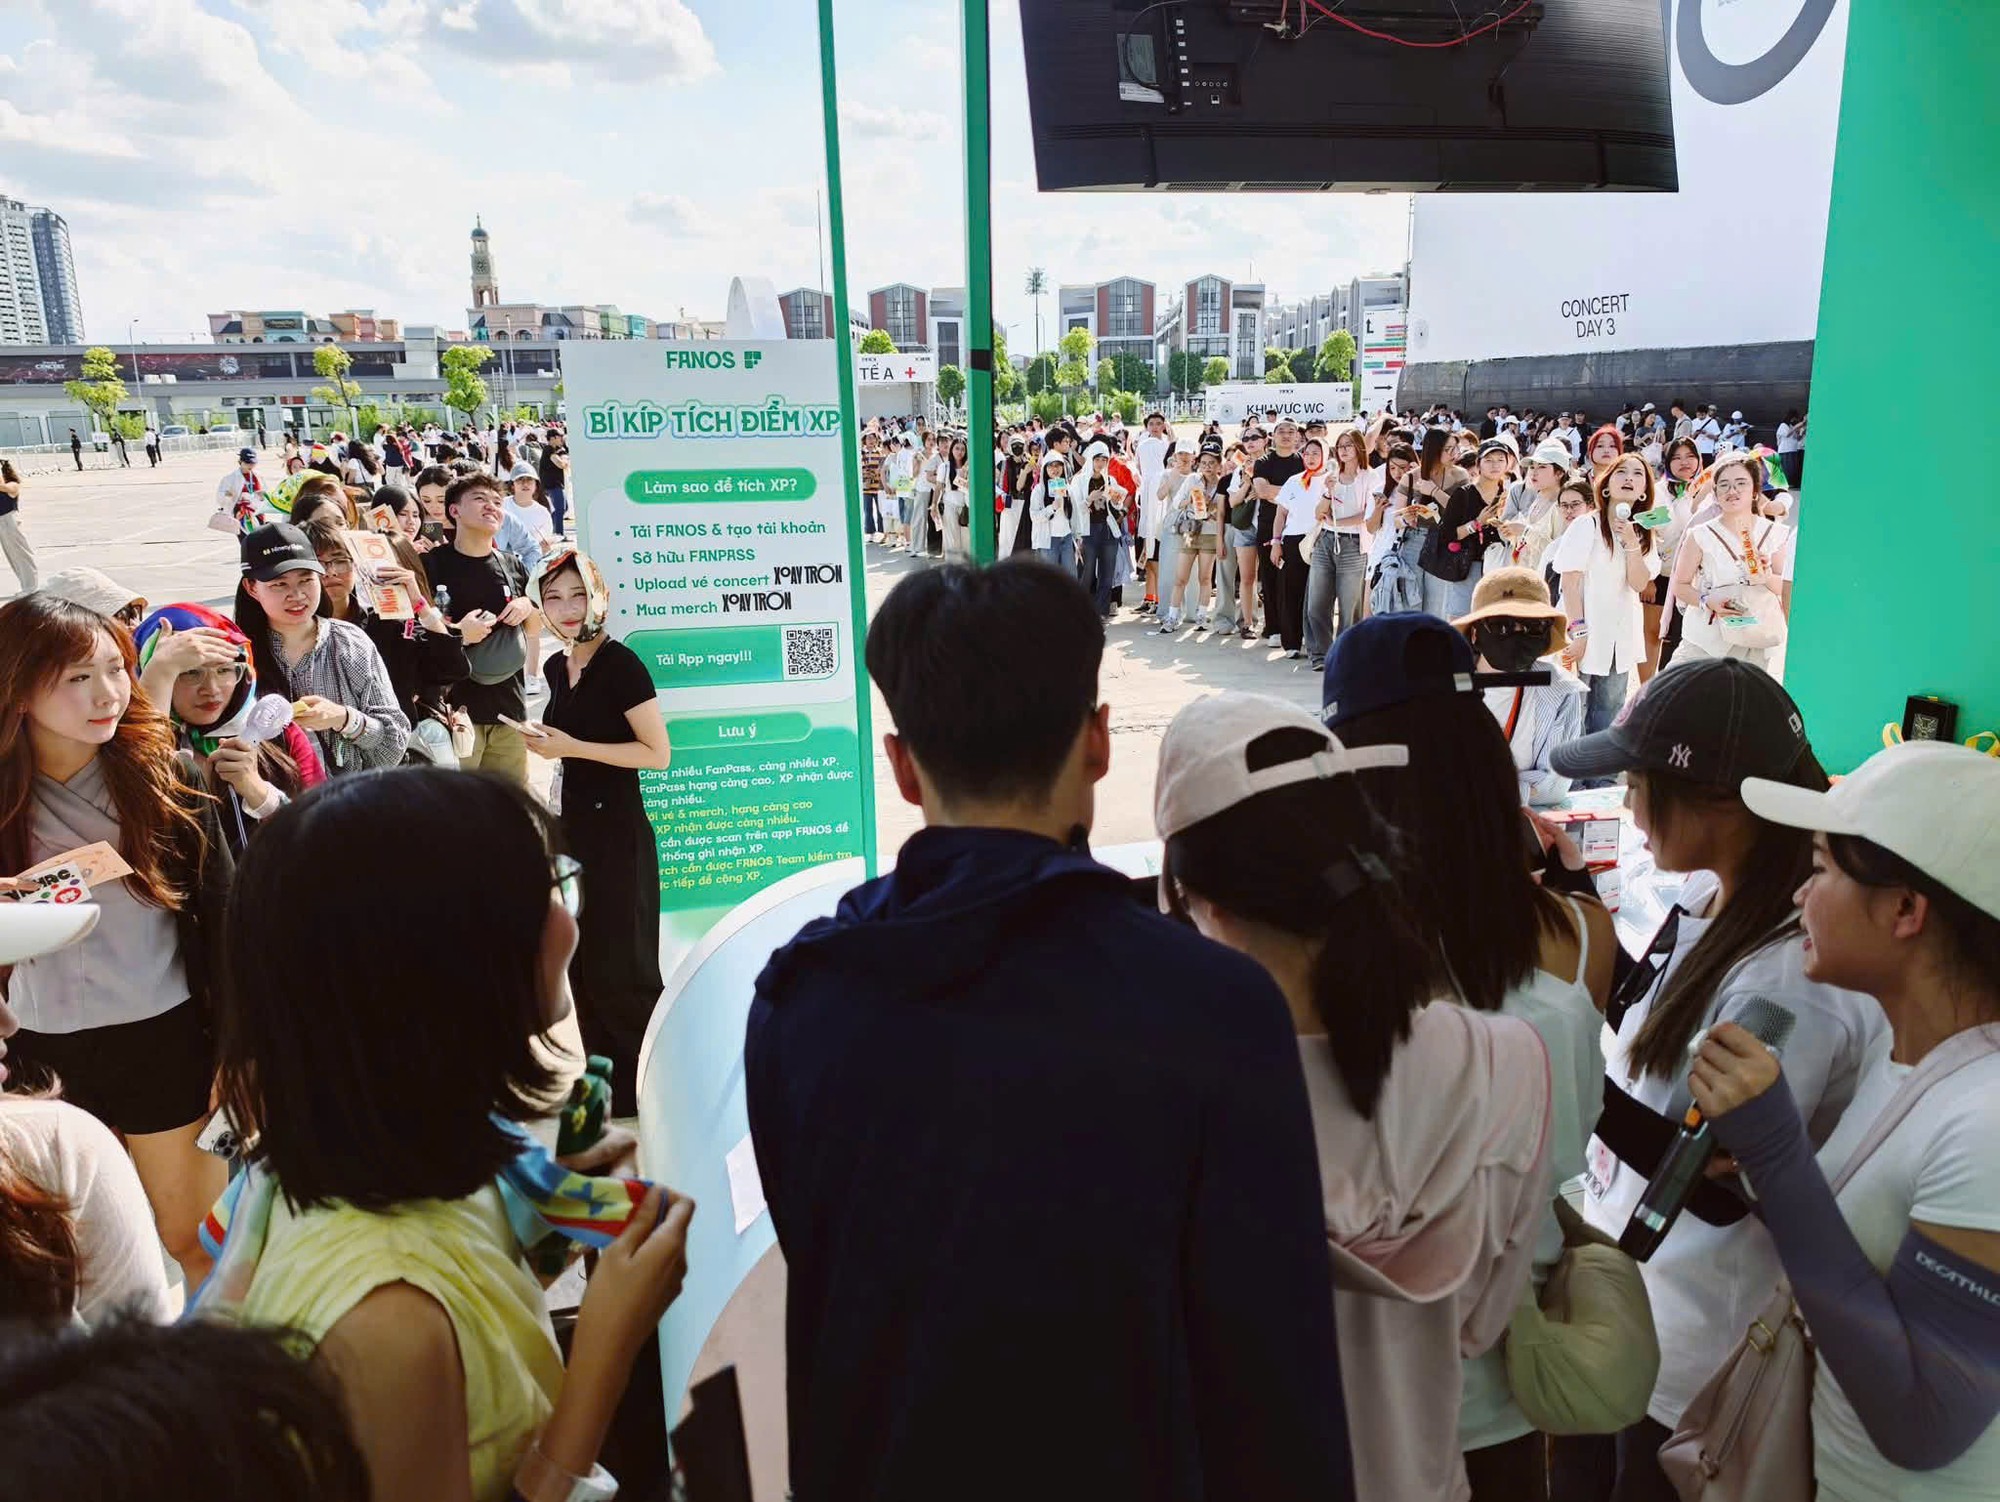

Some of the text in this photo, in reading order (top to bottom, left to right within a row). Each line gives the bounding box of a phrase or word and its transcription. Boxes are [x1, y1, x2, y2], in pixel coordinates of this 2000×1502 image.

[1561, 293, 1630, 318] CONCERT
[1576, 317, 1616, 338] DAY 3
[666, 351, 736, 369] FANOS
[859, 362, 894, 380] TẾ A
[591, 400, 841, 433] BÍ KÍP TÍCH ĐIỂM XP
[1303, 402, 1324, 414] WC
[645, 477, 797, 494] Làm sao để tích XP?
[630, 520, 826, 538] Tải FANOS & tạo tài khoản
[632, 548, 756, 565] Sở hữu FANPASS
[634, 576, 687, 592] Upload
[692, 575, 708, 588] vé
[713, 573, 770, 587] concert
[636, 603, 667, 616] Mua
[671, 601, 718, 615] merch
[656, 651, 752, 668] Tải App ngay!!!
[718, 721, 758, 738] Lưu ý
[1668, 742, 1693, 768] NY
[638, 769, 669, 781] Càng
[671, 765, 703, 778] nhiều
[705, 763, 755, 775] FanPass,
[822, 756, 840, 766] XP.
[640, 782, 686, 794] FanPass
[751, 776, 775, 786] cao,
[779, 773, 794, 784] XP
[796, 772, 824, 783] nhận
[827, 770, 854, 780] được
[678, 809, 686, 819] &
[689, 807, 728, 818] merch,
[792, 801, 813, 810] cao
[655, 824, 671, 835] XP
[674, 823, 703, 834] nhận
[705, 820, 734, 831] được
[685, 836, 713, 847] được
[716, 833, 742, 843] scan
[745, 830, 768, 840] trên
[771, 829, 792, 839] app
[662, 844, 767, 862] thống ghi nhận XP.
[705, 860, 734, 871] được
[776, 854, 805, 864] Team
[746, 870, 764, 880] XP.
